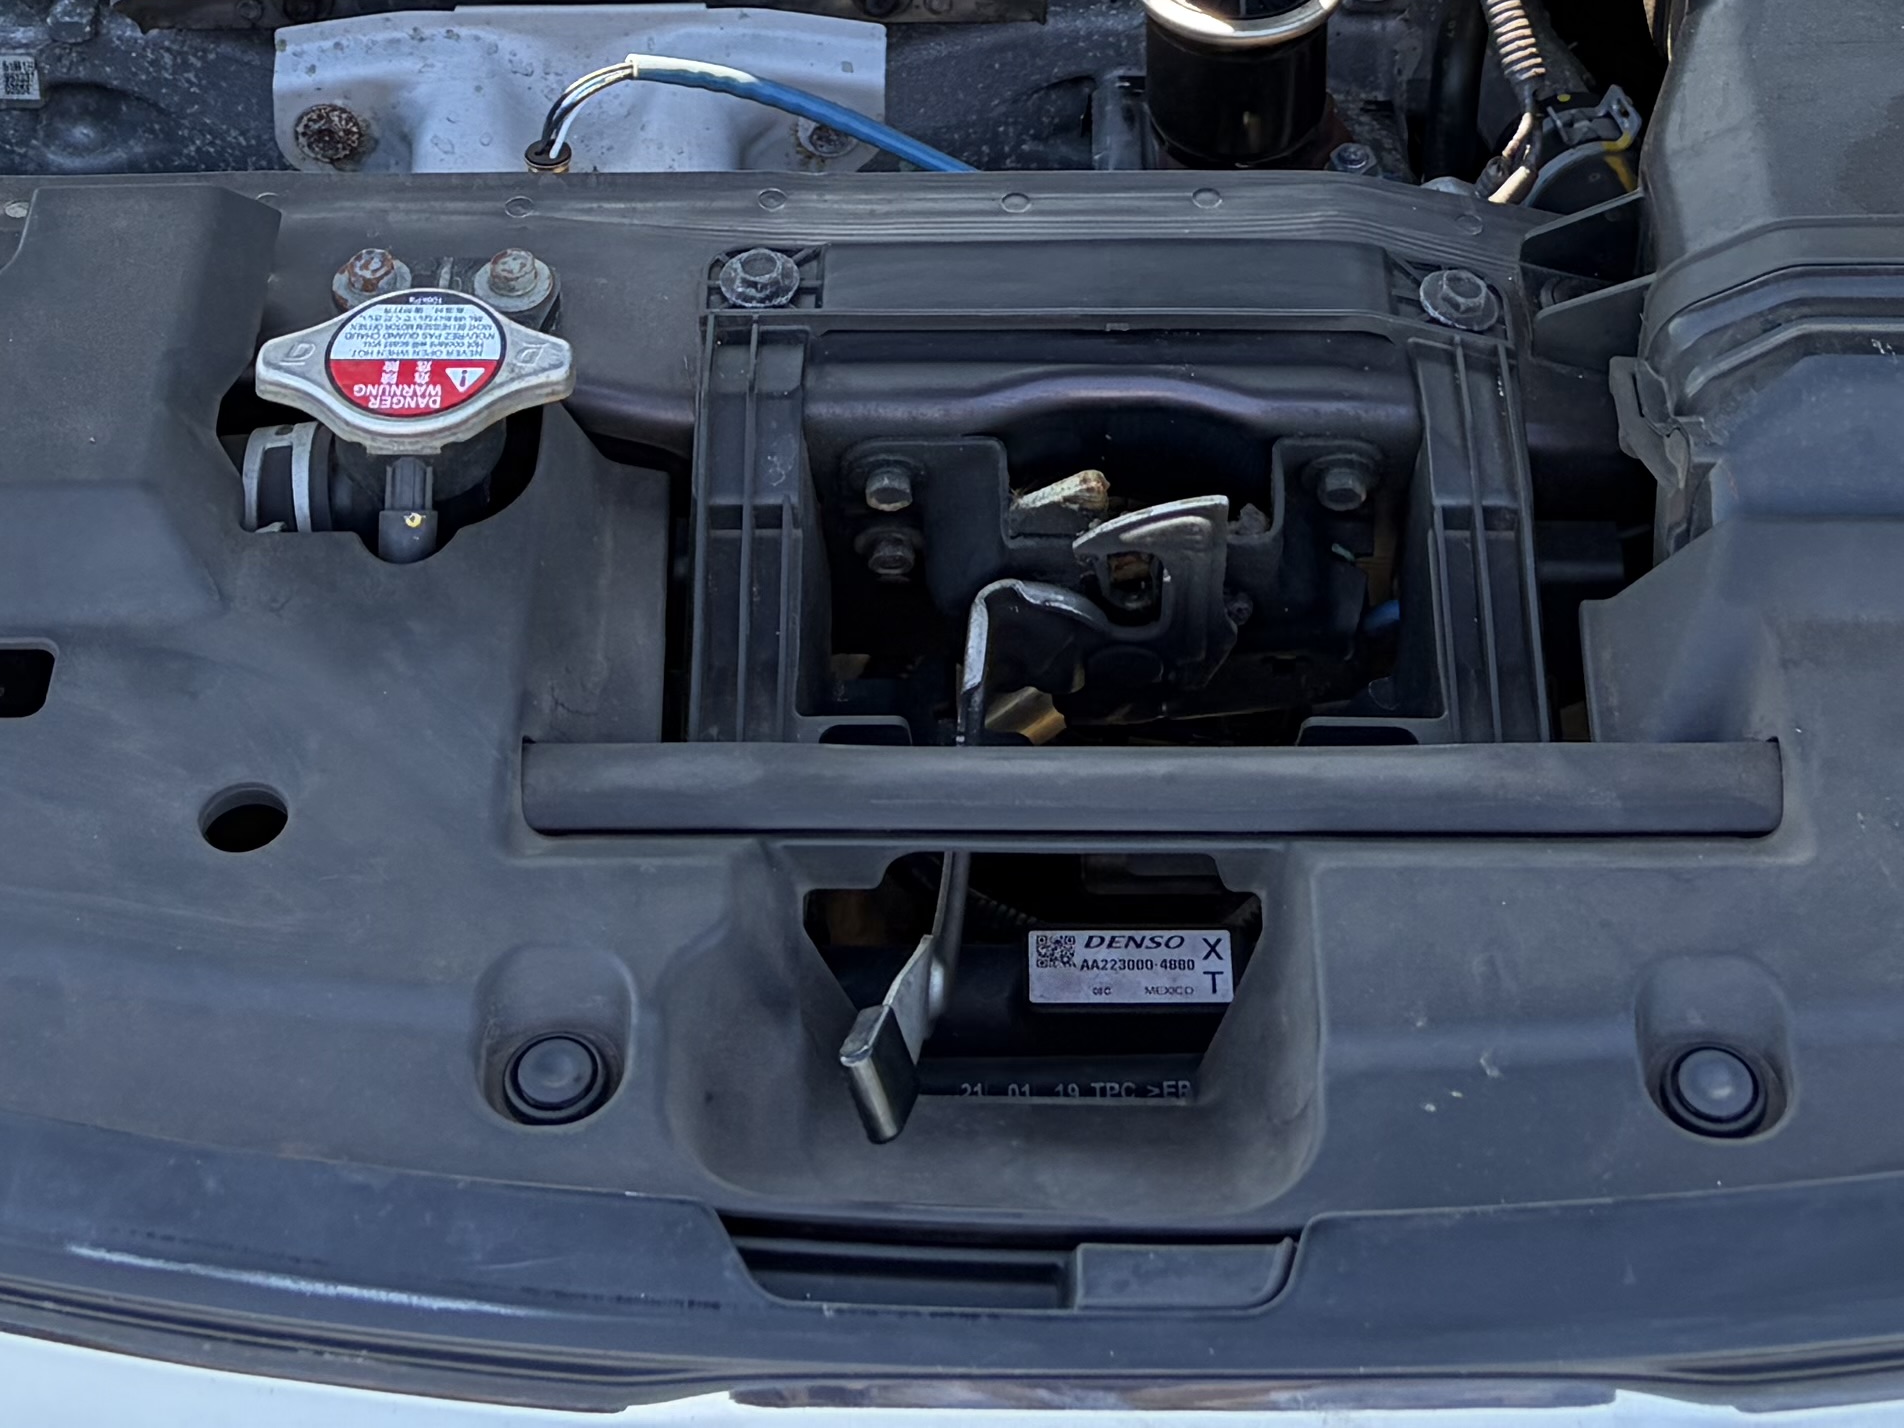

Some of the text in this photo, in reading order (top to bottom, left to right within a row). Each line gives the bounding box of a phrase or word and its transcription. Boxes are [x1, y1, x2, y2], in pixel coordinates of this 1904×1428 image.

[383, 332, 420, 341] QUAND
[422, 332, 443, 341] PAS
[376, 348, 410, 358] WHEN
[412, 348, 444, 358] OPEN
[446, 348, 483, 358] NEVER
[353, 384, 442, 397] WARNUNG
[368, 396, 442, 409] DANGER
[1083, 934, 1186, 950] DENSO
[1202, 937, 1224, 961] X
[1202, 970, 1225, 994] T
[1143, 985, 1195, 996] MEXICO
[1054, 1082, 1080, 1098] 19
[1090, 1081, 1137, 1098] TPC
